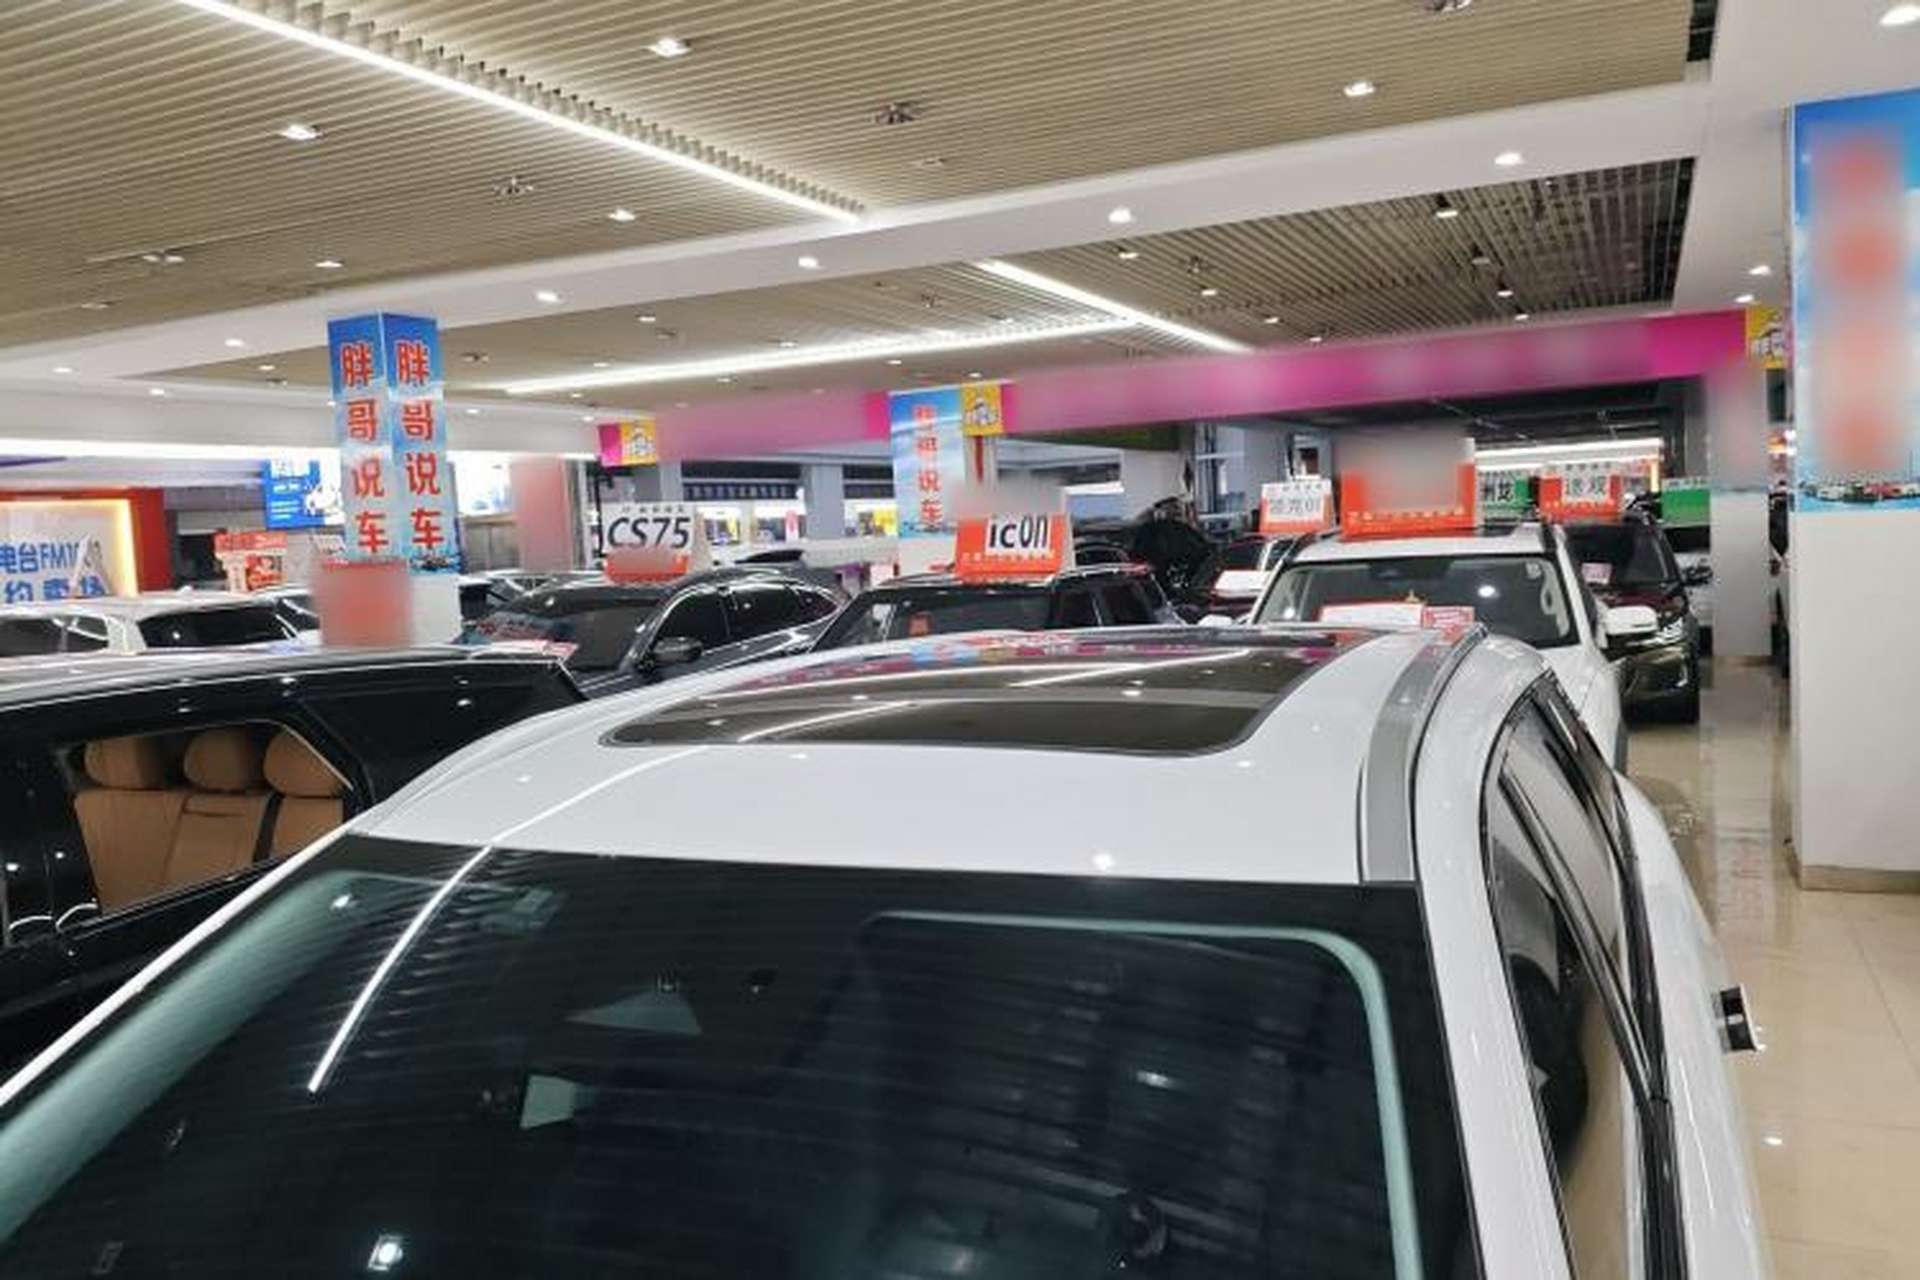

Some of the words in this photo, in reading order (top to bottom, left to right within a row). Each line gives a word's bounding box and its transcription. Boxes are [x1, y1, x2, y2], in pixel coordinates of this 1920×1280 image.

[340, 341, 389, 553] 胖哥说车
[396, 340, 445, 550] 胖哥说车
[607, 516, 691, 549] CS75
